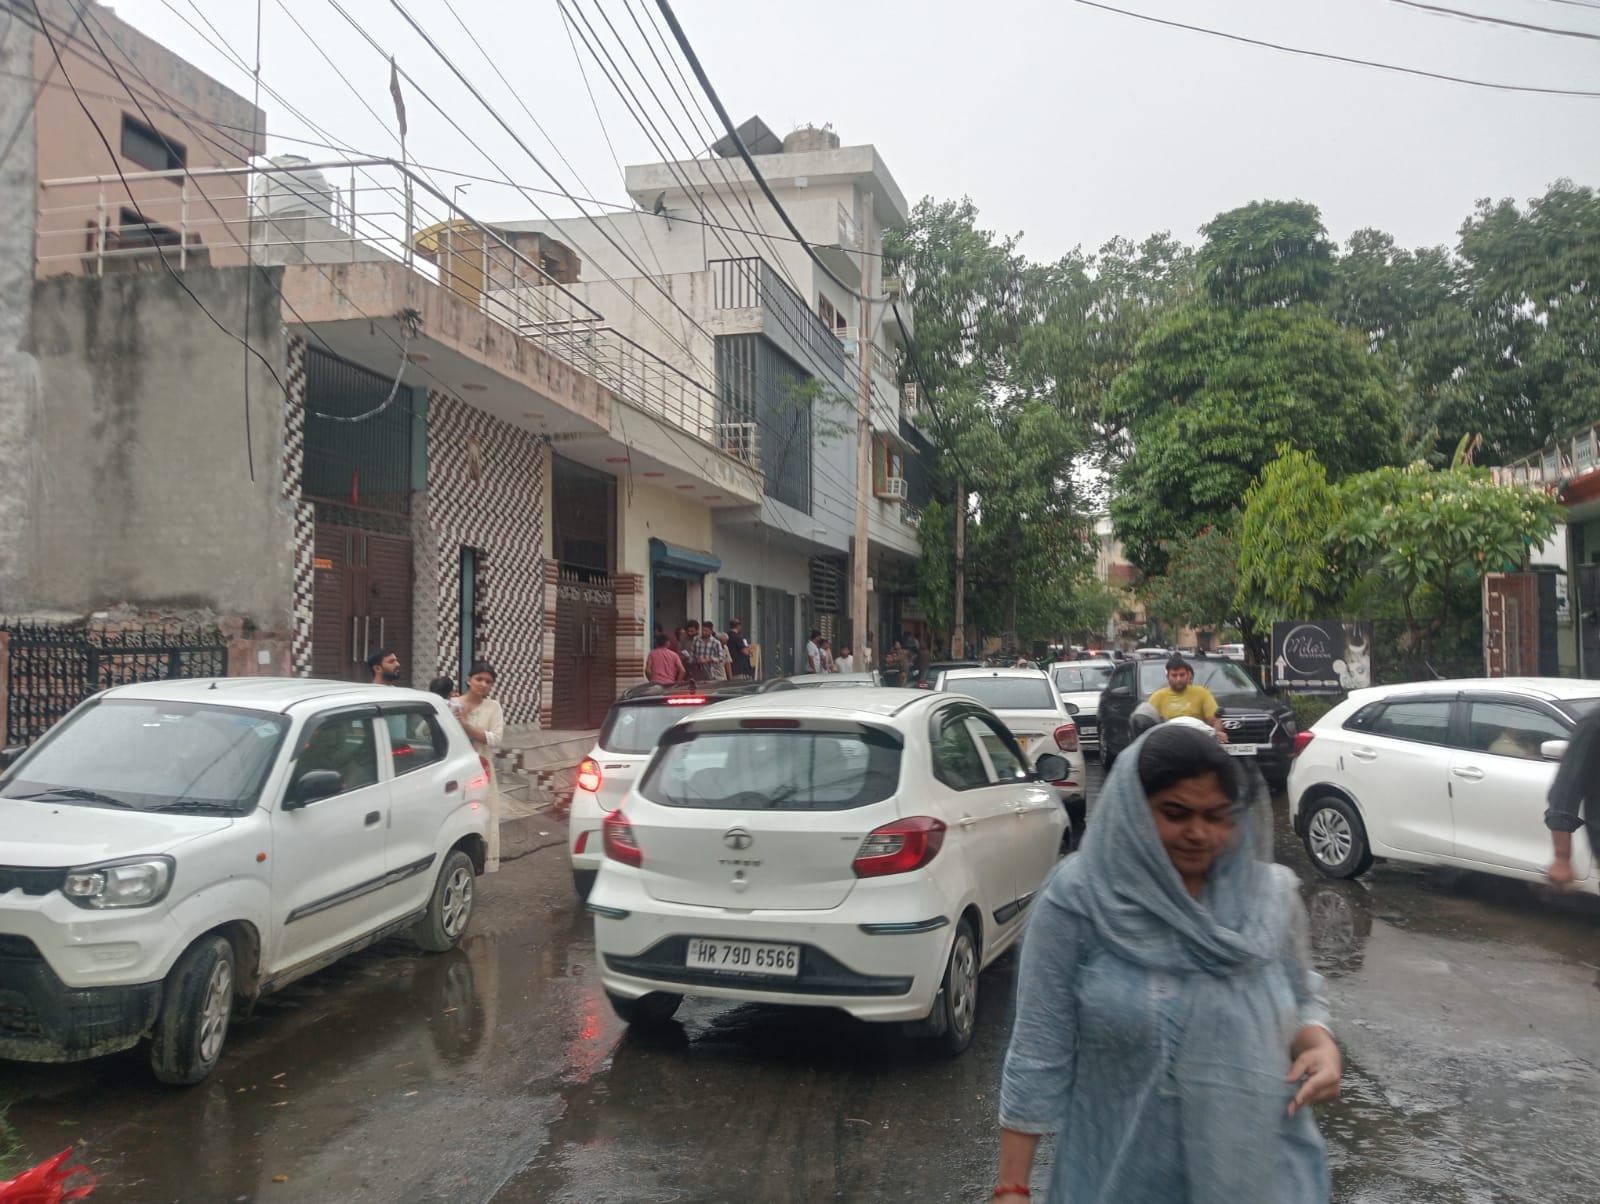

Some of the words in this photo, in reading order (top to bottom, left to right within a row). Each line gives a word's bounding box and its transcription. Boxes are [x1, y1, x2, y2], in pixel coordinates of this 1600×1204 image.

[698, 943, 717, 963] HR
[722, 946, 751, 966] 79D
[756, 949, 796, 969] 6566
